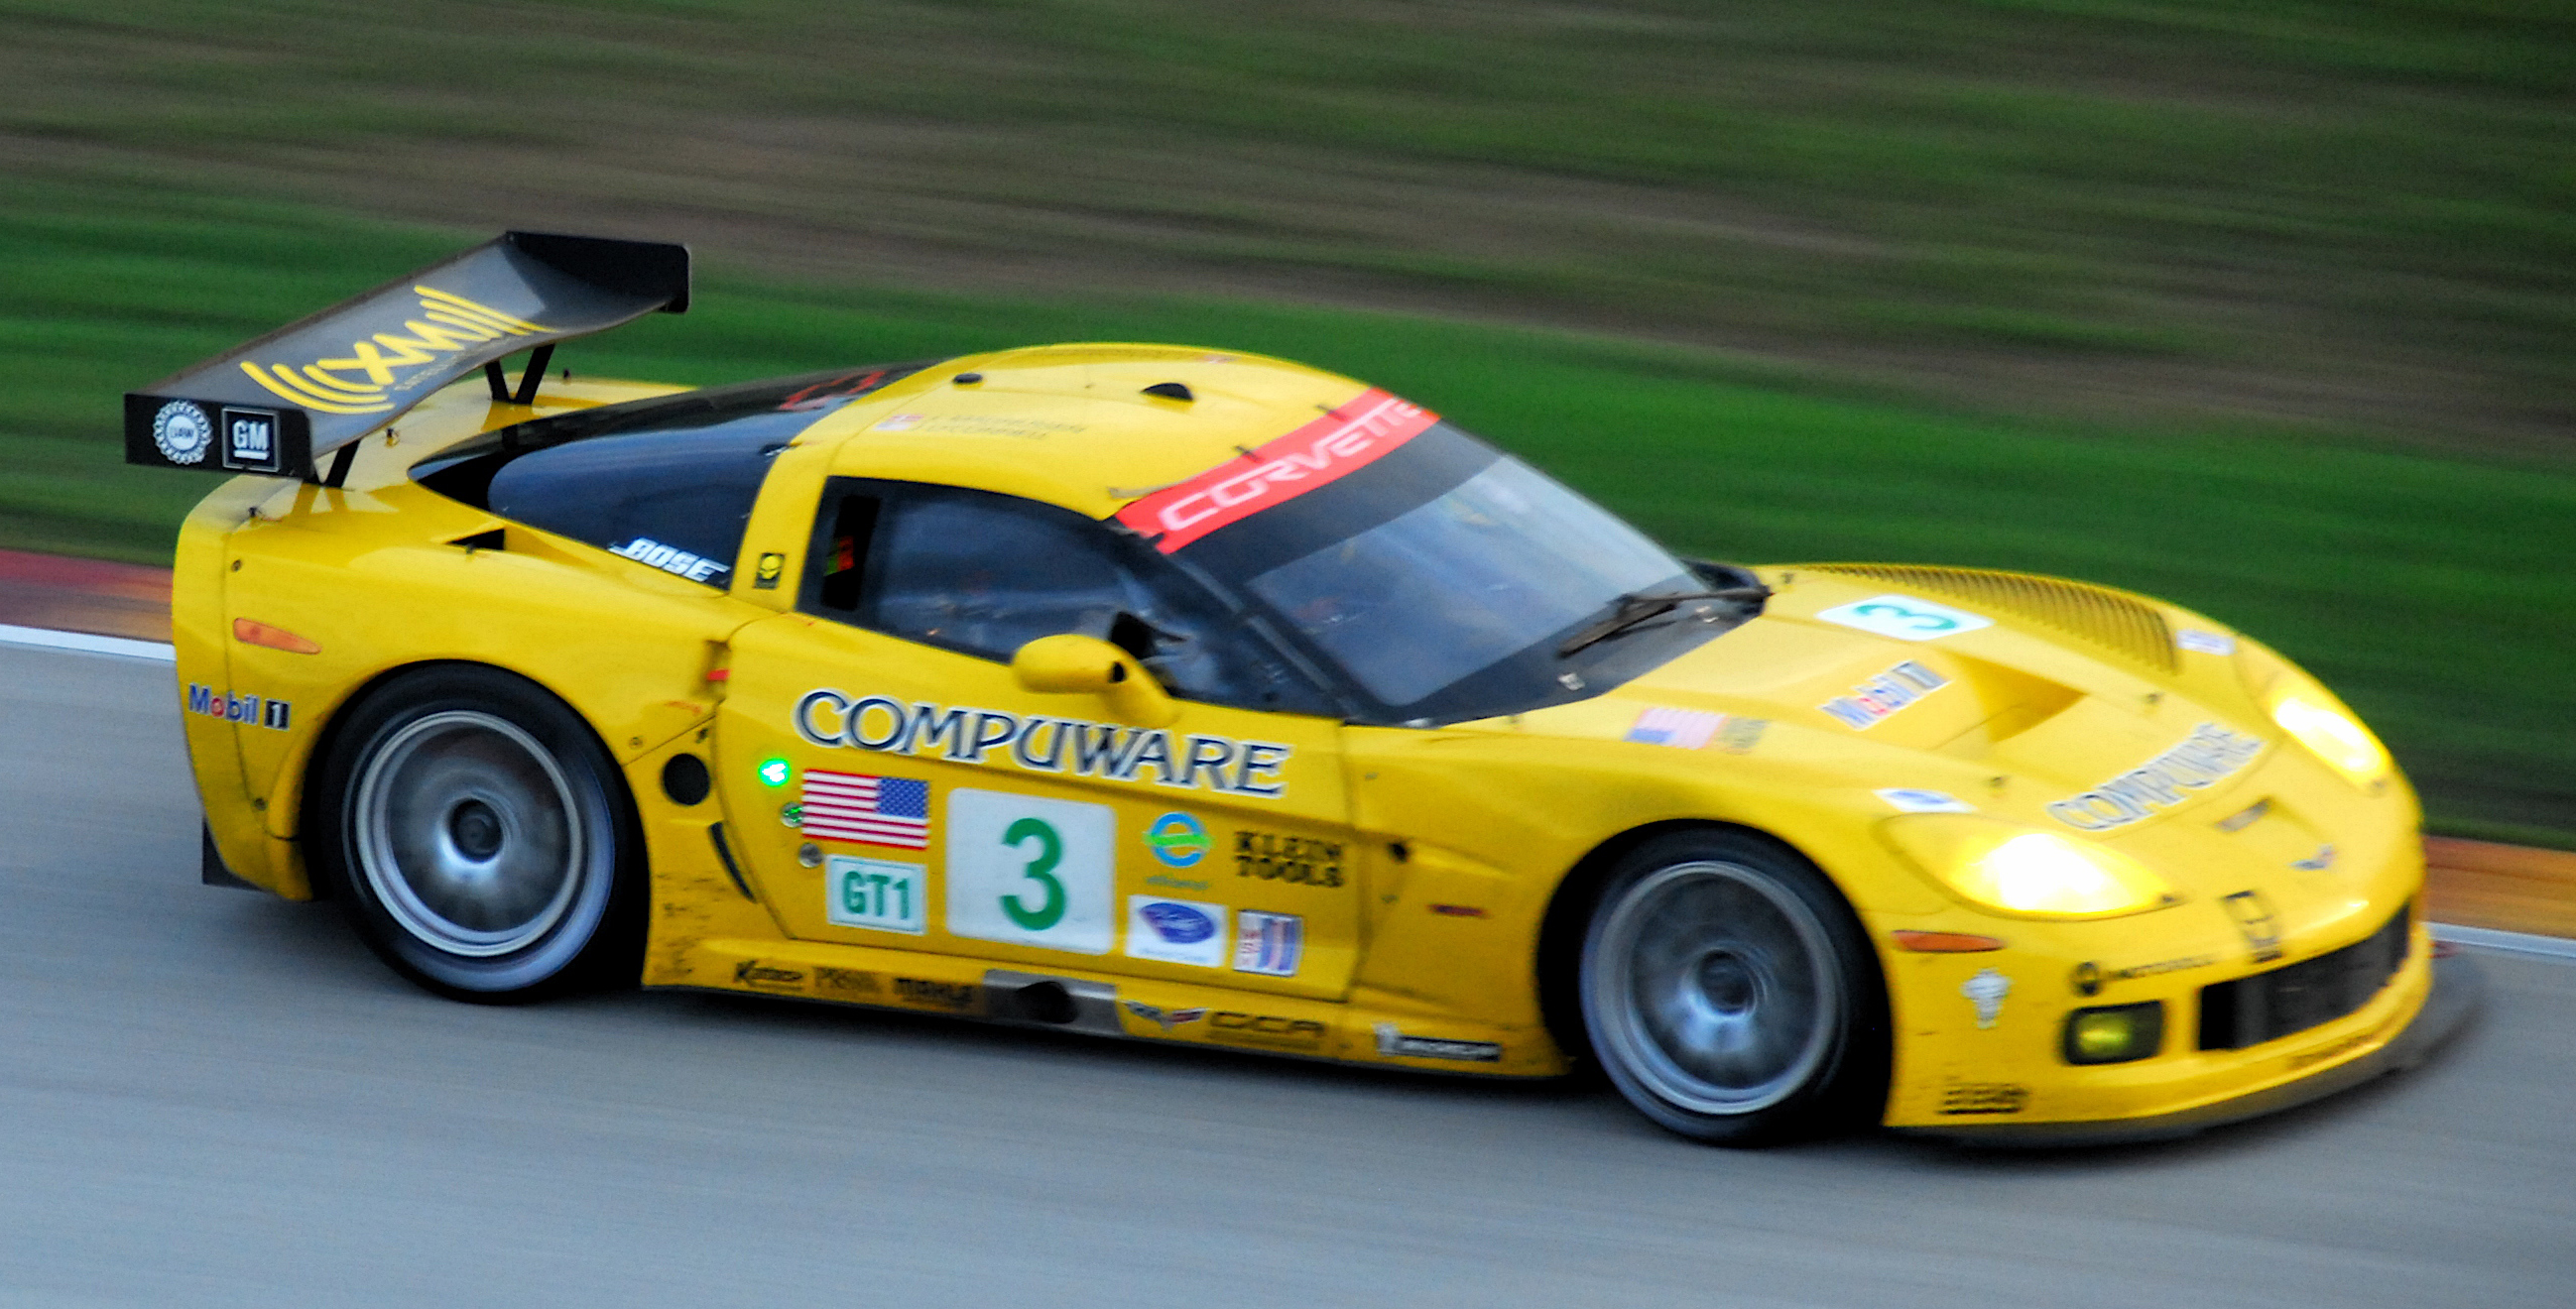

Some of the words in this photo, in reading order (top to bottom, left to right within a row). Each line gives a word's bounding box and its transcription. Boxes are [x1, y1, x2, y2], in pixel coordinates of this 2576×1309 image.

[232, 418, 270, 450] GM
[1158, 397, 1421, 532] CORVETTE
[607, 536, 731, 583] BOSE
[1853, 604, 1958, 631] 3
[188, 682, 260, 726] Mobil
[796, 689, 1295, 797] COMPUWARE
[841, 870, 910, 920] GT1
[1000, 818, 1066, 931] 3
[1235, 855, 1343, 889] TOOLS
